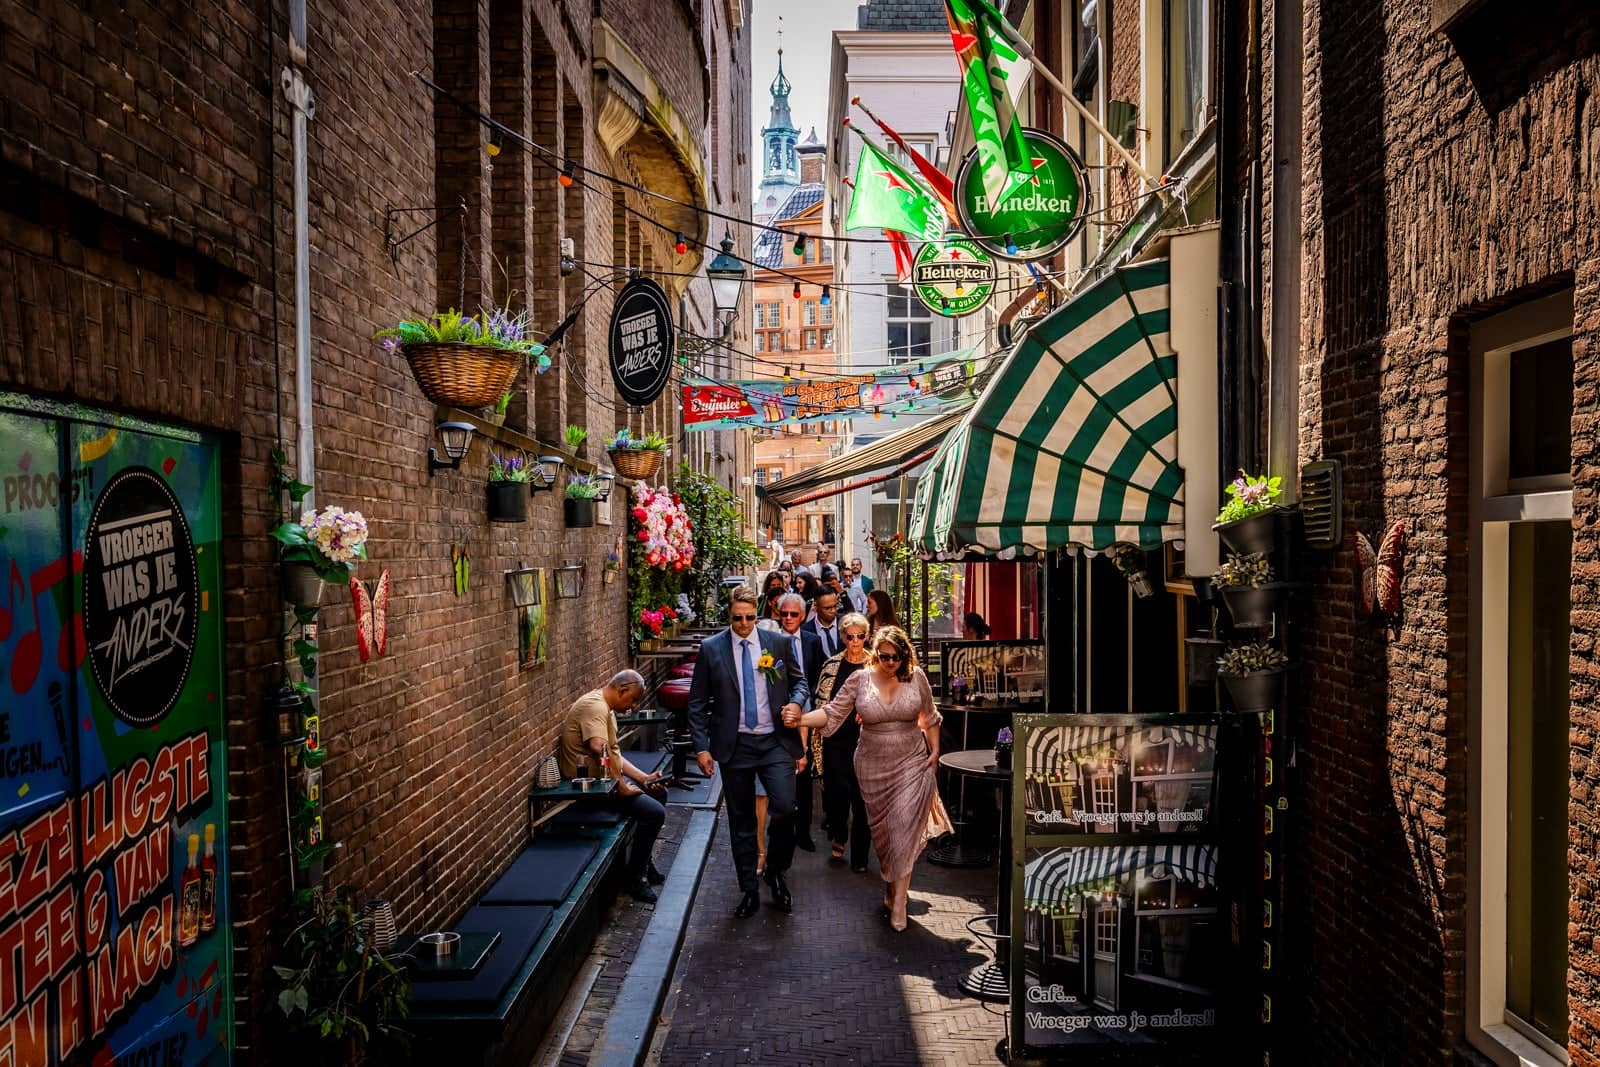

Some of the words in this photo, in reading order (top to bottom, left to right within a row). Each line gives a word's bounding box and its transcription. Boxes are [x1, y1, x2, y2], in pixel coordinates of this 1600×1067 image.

[974, 192, 1070, 213] Hineken
[921, 265, 988, 280] Heineken
[958, 288, 984, 308] QUALITY
[620, 313, 657, 335] VROEGER
[621, 331, 645, 351] WAS
[646, 326, 658, 345] JE
[618, 342, 662, 378] ANDERS
[935, 372, 952, 382] WAS
[840, 384, 859, 396] VAN
[100, 519, 174, 566] VROEGER
[102, 564, 150, 611] WAS
[154, 552, 177, 594] JE
[95, 592, 189, 692] ANDERS
[1072, 809, 1119, 825] Vroeger
[1120, 811, 1143, 823] was
[1143, 809, 1156, 825] je
[1157, 808, 1203, 823] anders!!
[114, 822, 170, 917] VAN
[60, 893, 174, 1062] HAAG!
[1027, 983, 1077, 1003] Café...
[1027, 1011, 1092, 1033] Vroeger
[1094, 1014, 1127, 1028] was
[1129, 1010, 1146, 1032] je
